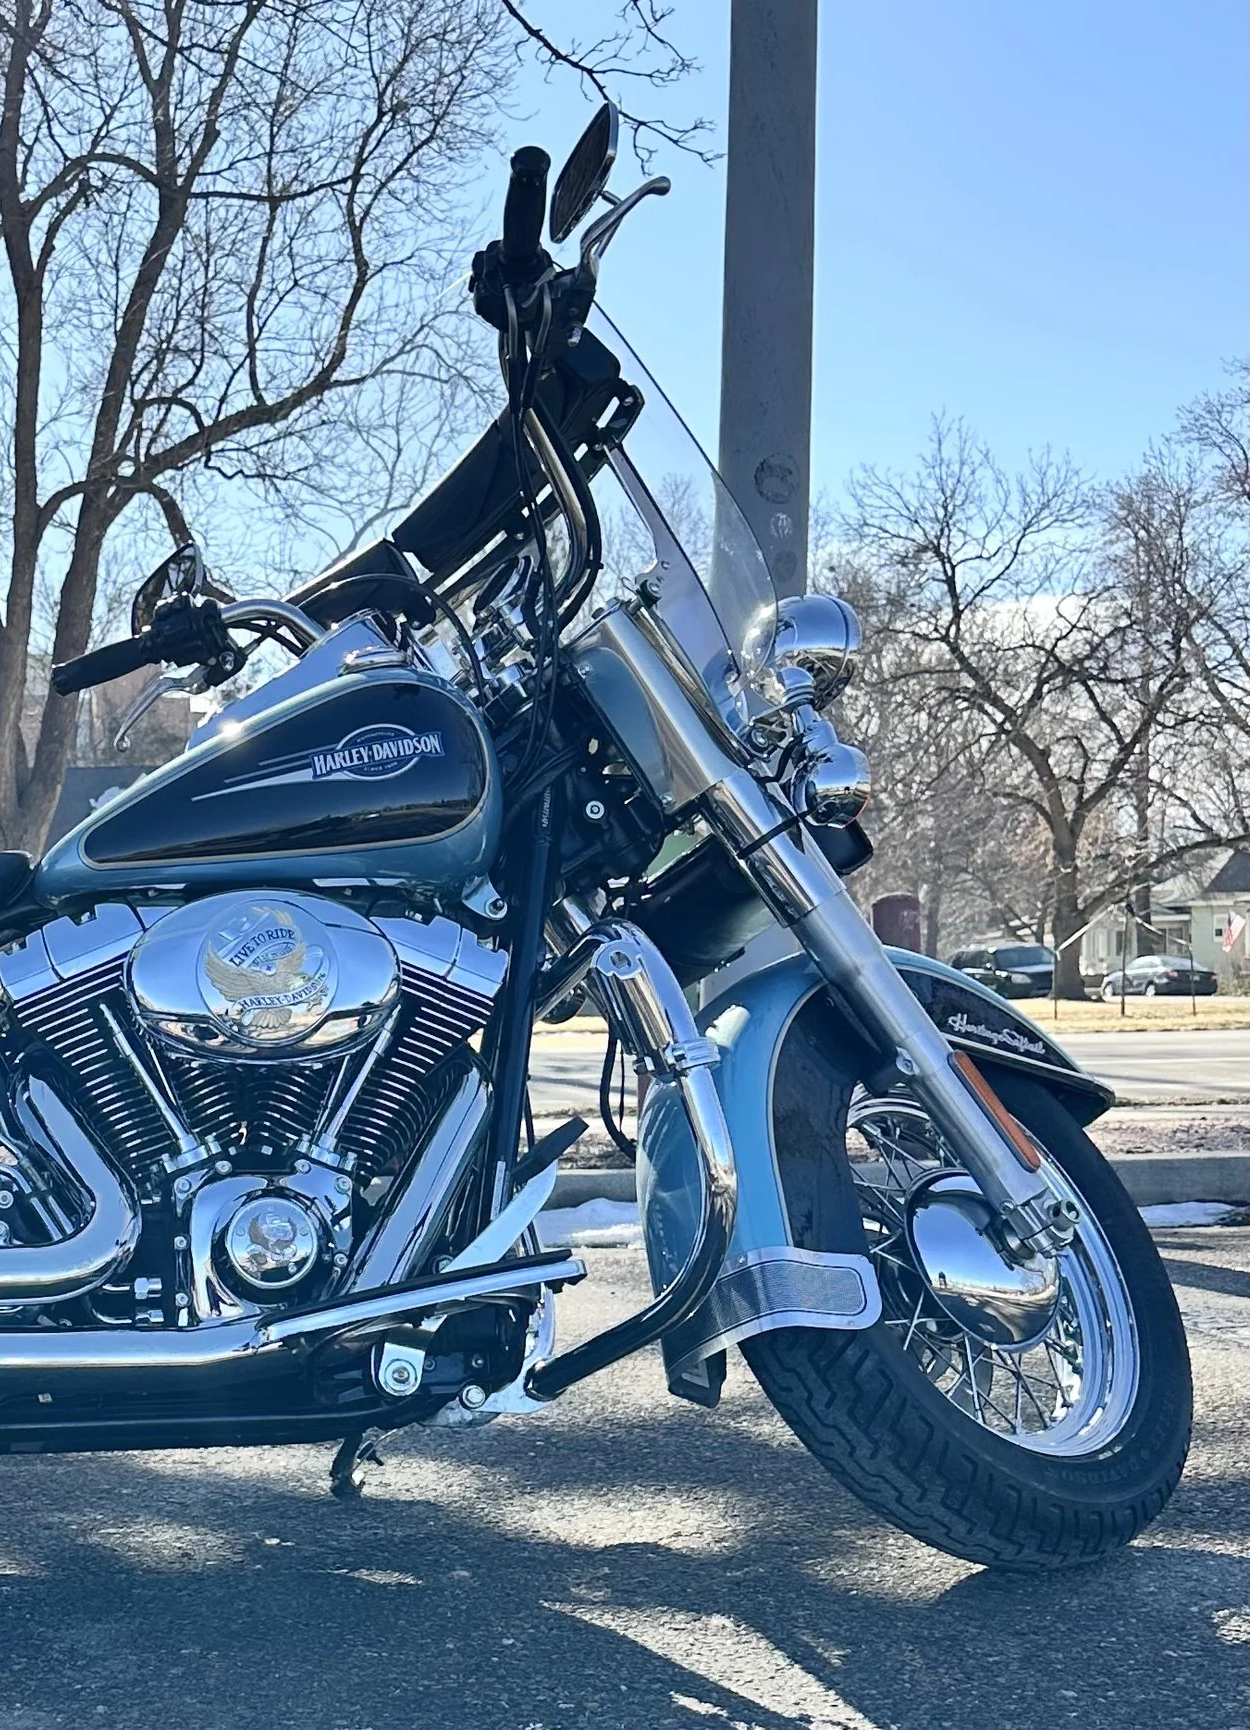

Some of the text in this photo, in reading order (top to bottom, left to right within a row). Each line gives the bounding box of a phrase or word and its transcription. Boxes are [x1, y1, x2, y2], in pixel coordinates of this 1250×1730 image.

[229, 942, 255, 967] LIVE
[253, 933, 267, 946] TO
[266, 928, 295, 940] RIDE
